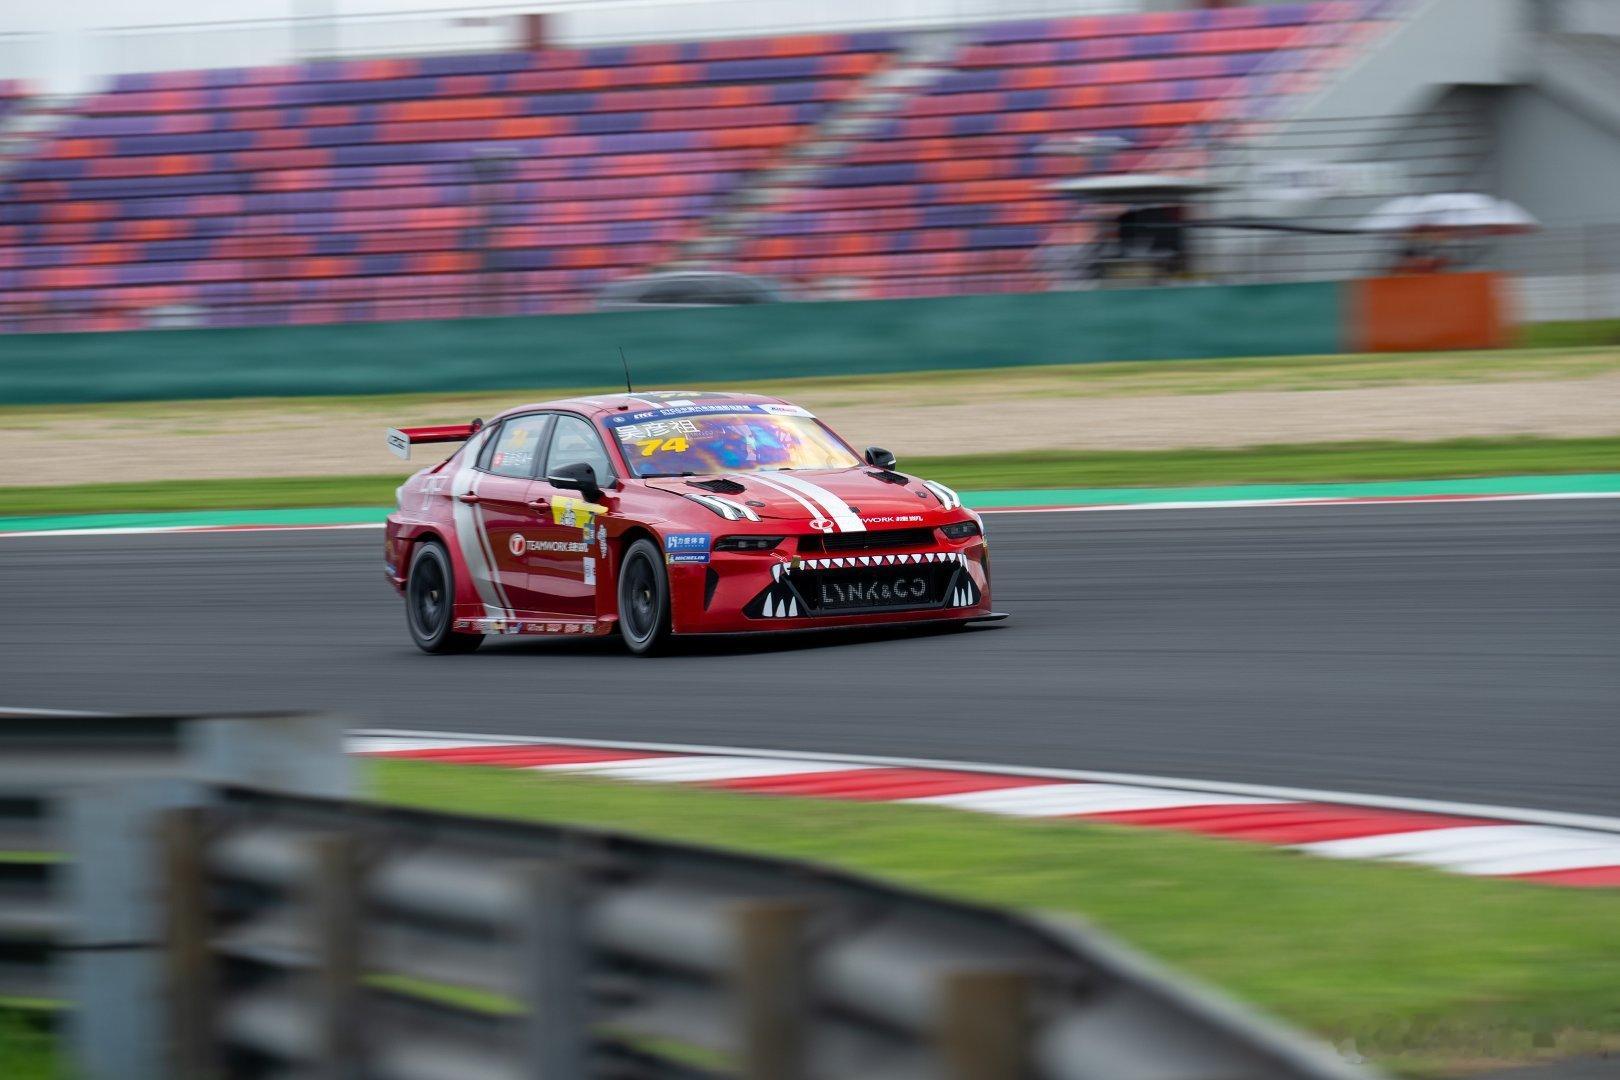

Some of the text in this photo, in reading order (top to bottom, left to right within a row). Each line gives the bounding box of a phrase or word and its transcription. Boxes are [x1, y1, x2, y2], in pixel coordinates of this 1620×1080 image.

[616, 420, 700, 440] 吴彦祖
[637, 437, 689, 457] 74
[526, 541, 567, 551] TEAMWORK
